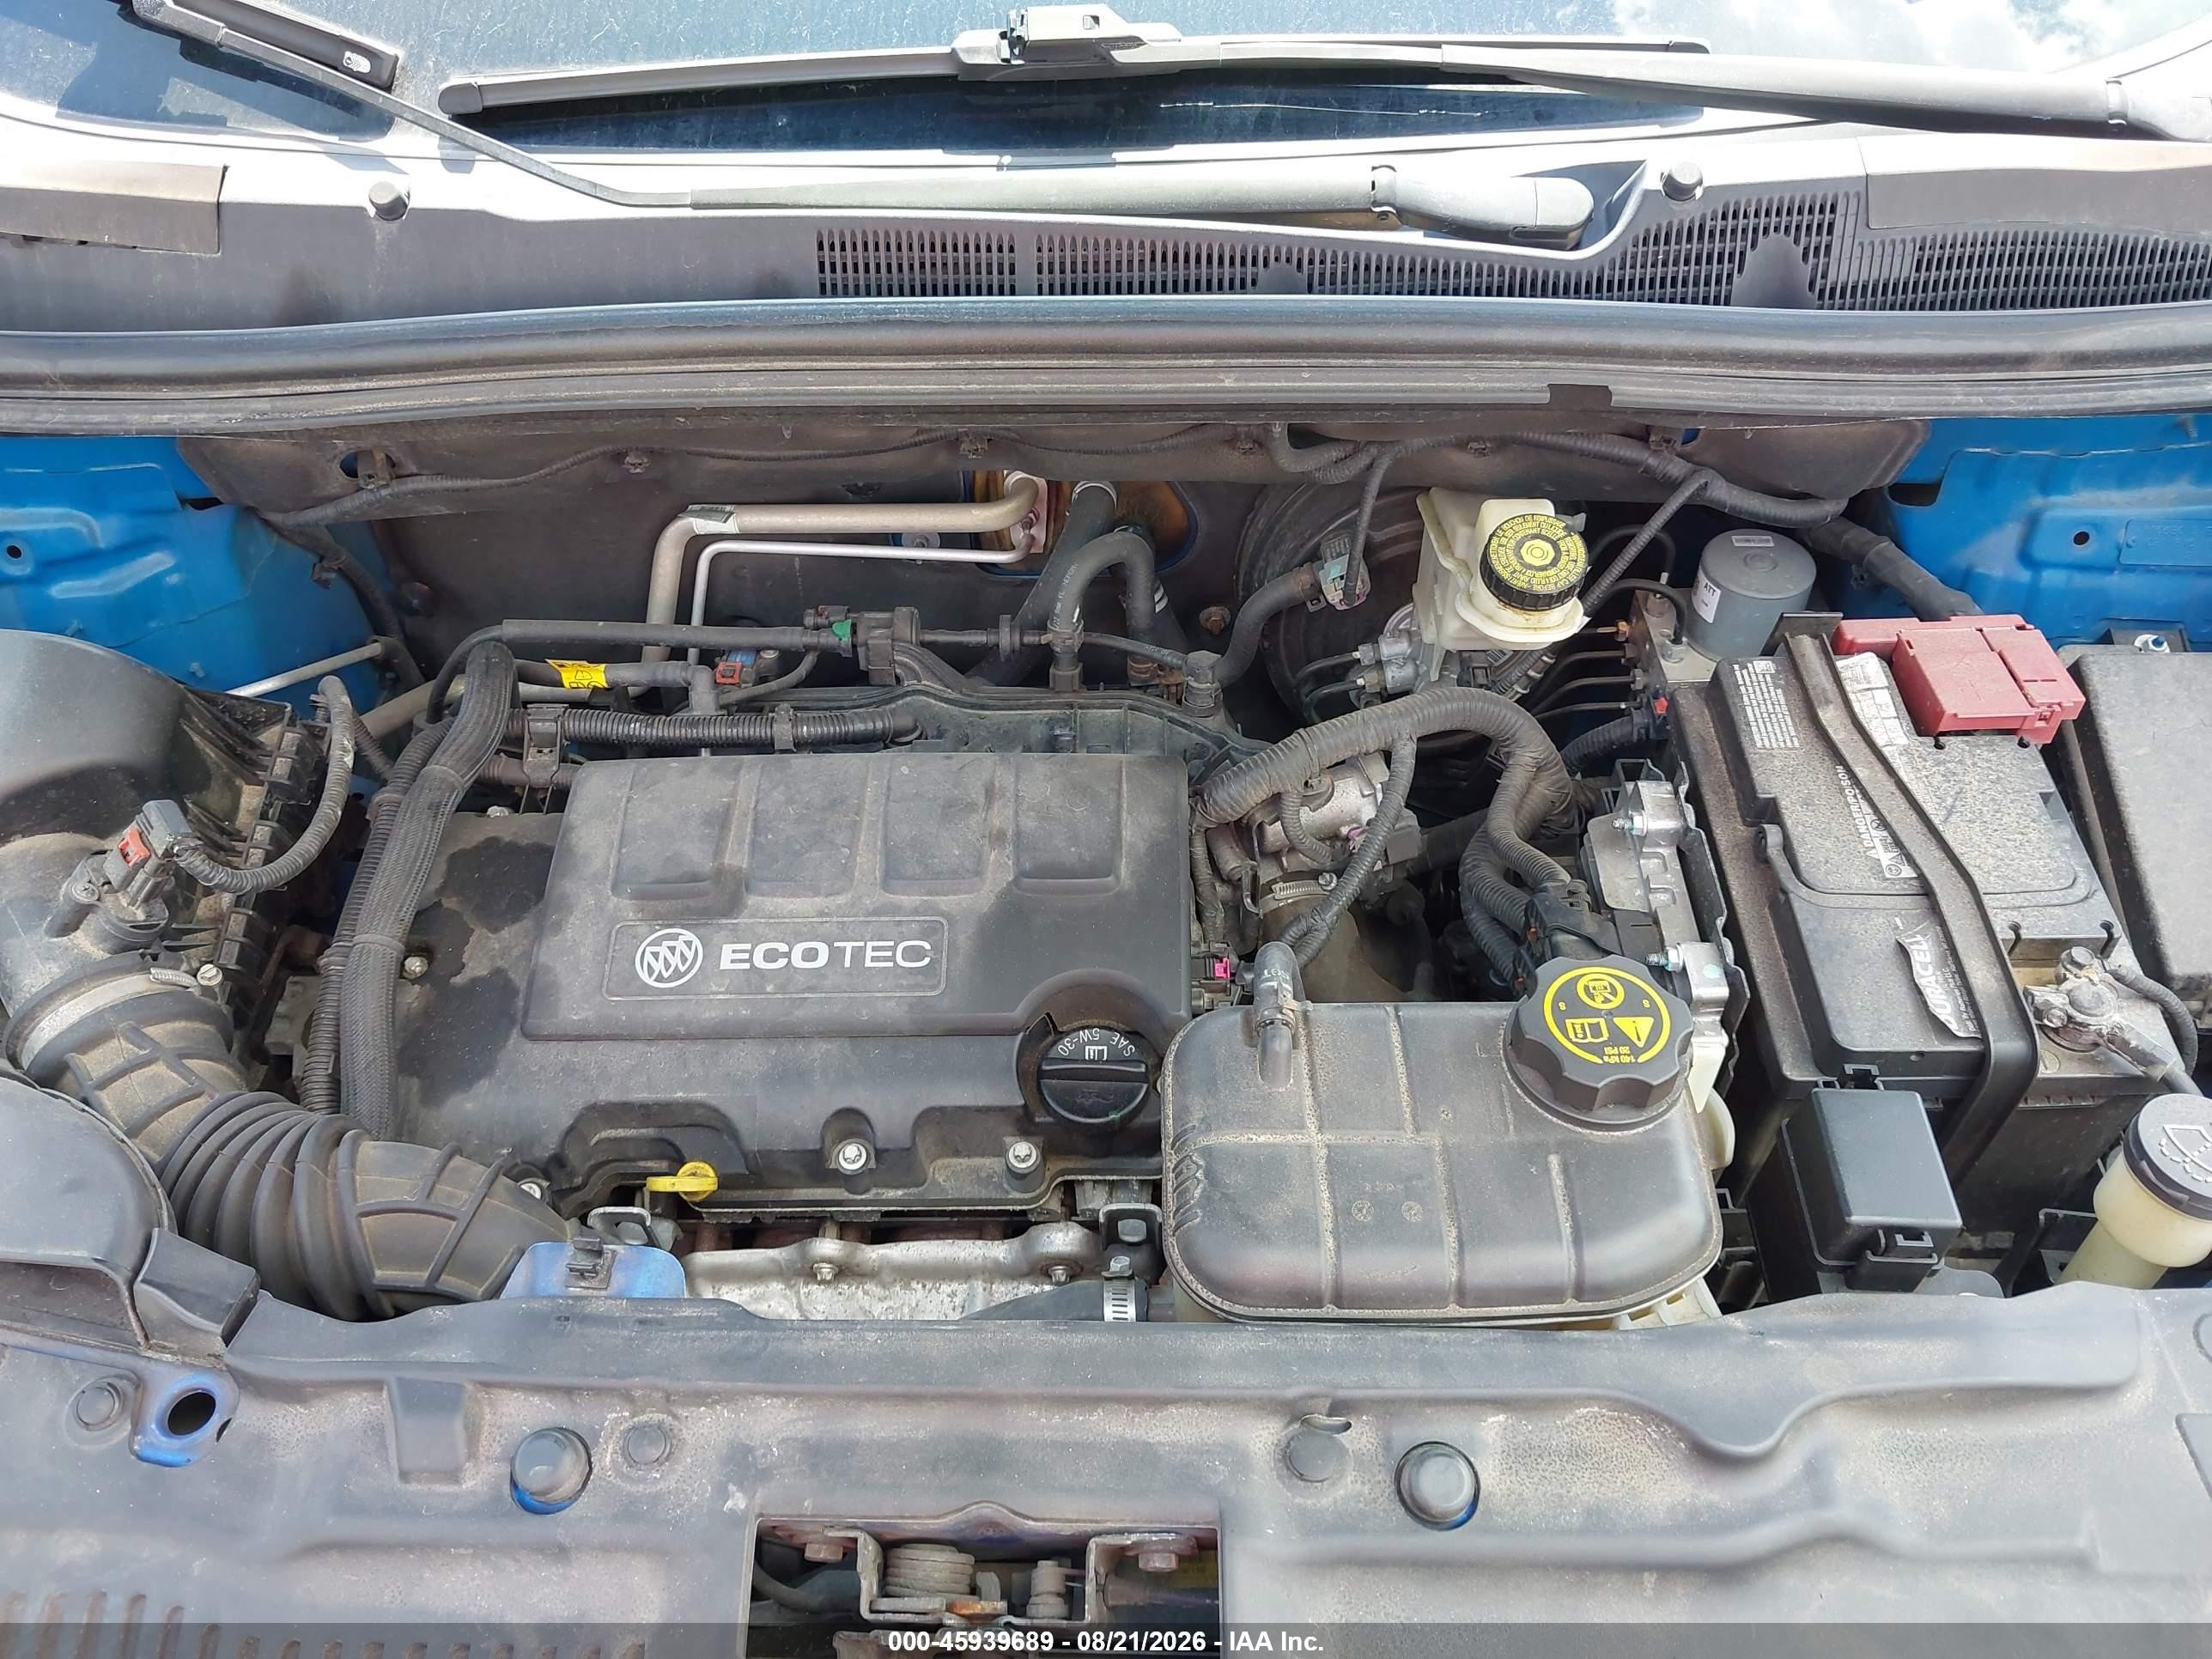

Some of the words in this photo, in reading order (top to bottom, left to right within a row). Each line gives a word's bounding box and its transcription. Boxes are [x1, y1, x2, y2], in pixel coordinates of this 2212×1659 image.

[720, 940, 932, 969] ECOTEC
[1058, 1028, 1100, 1056] 5W-30
[1109, 1031, 1135, 1057] SAE
